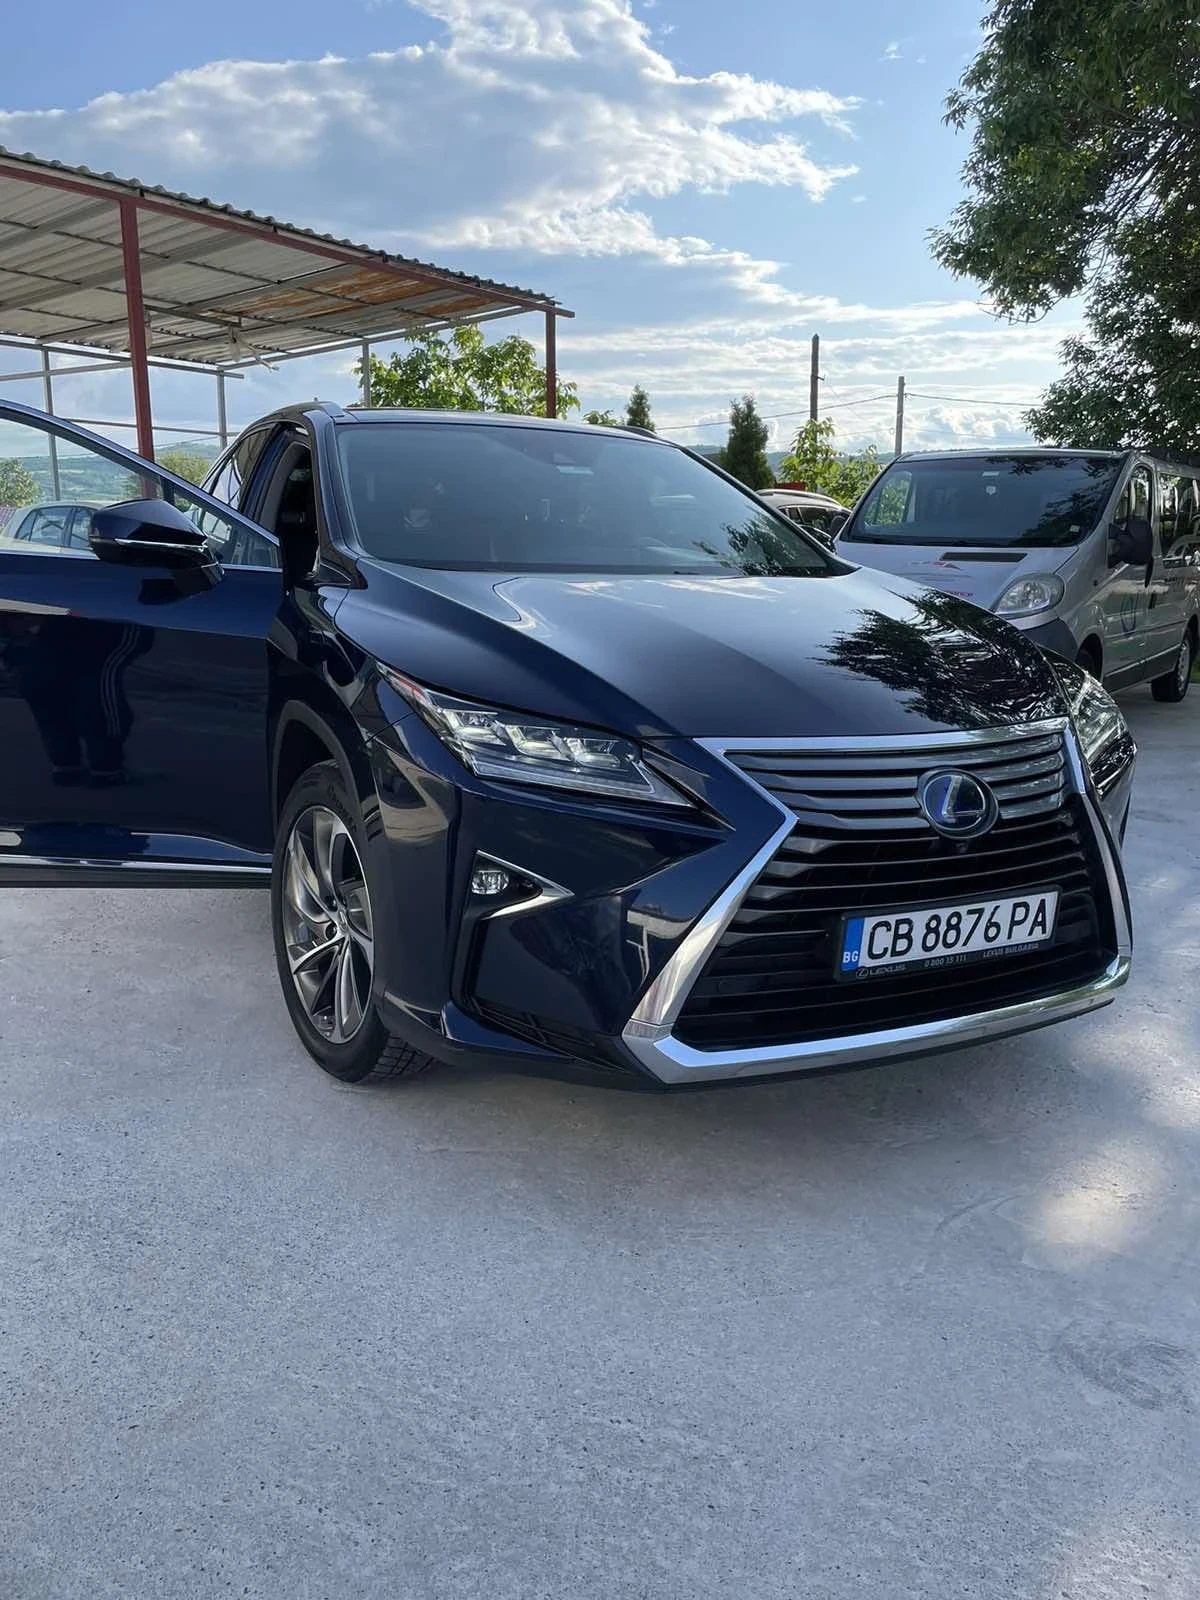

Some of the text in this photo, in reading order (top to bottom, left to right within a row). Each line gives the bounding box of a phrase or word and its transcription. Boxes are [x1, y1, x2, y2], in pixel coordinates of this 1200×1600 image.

[867, 898, 1047, 960] CB 8876 PA
[842, 951, 859, 963] BG
